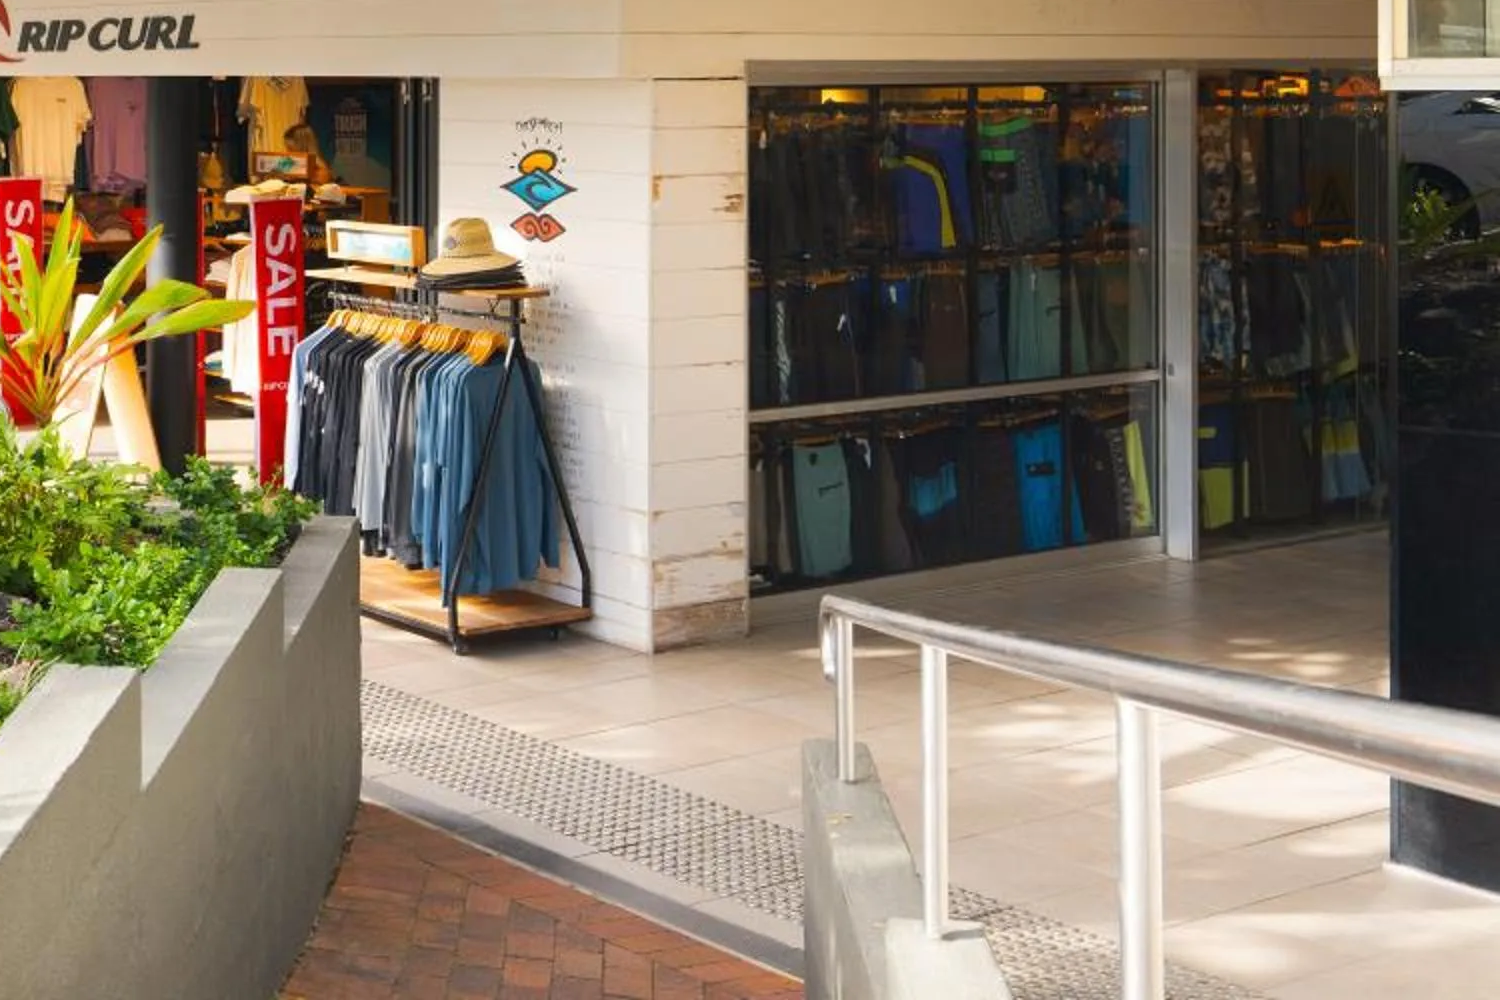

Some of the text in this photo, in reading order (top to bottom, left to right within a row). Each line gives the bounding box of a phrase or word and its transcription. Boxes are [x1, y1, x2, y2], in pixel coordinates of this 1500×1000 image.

[17, 15, 199, 52] RIP CURL
[265, 223, 299, 357] SALE
